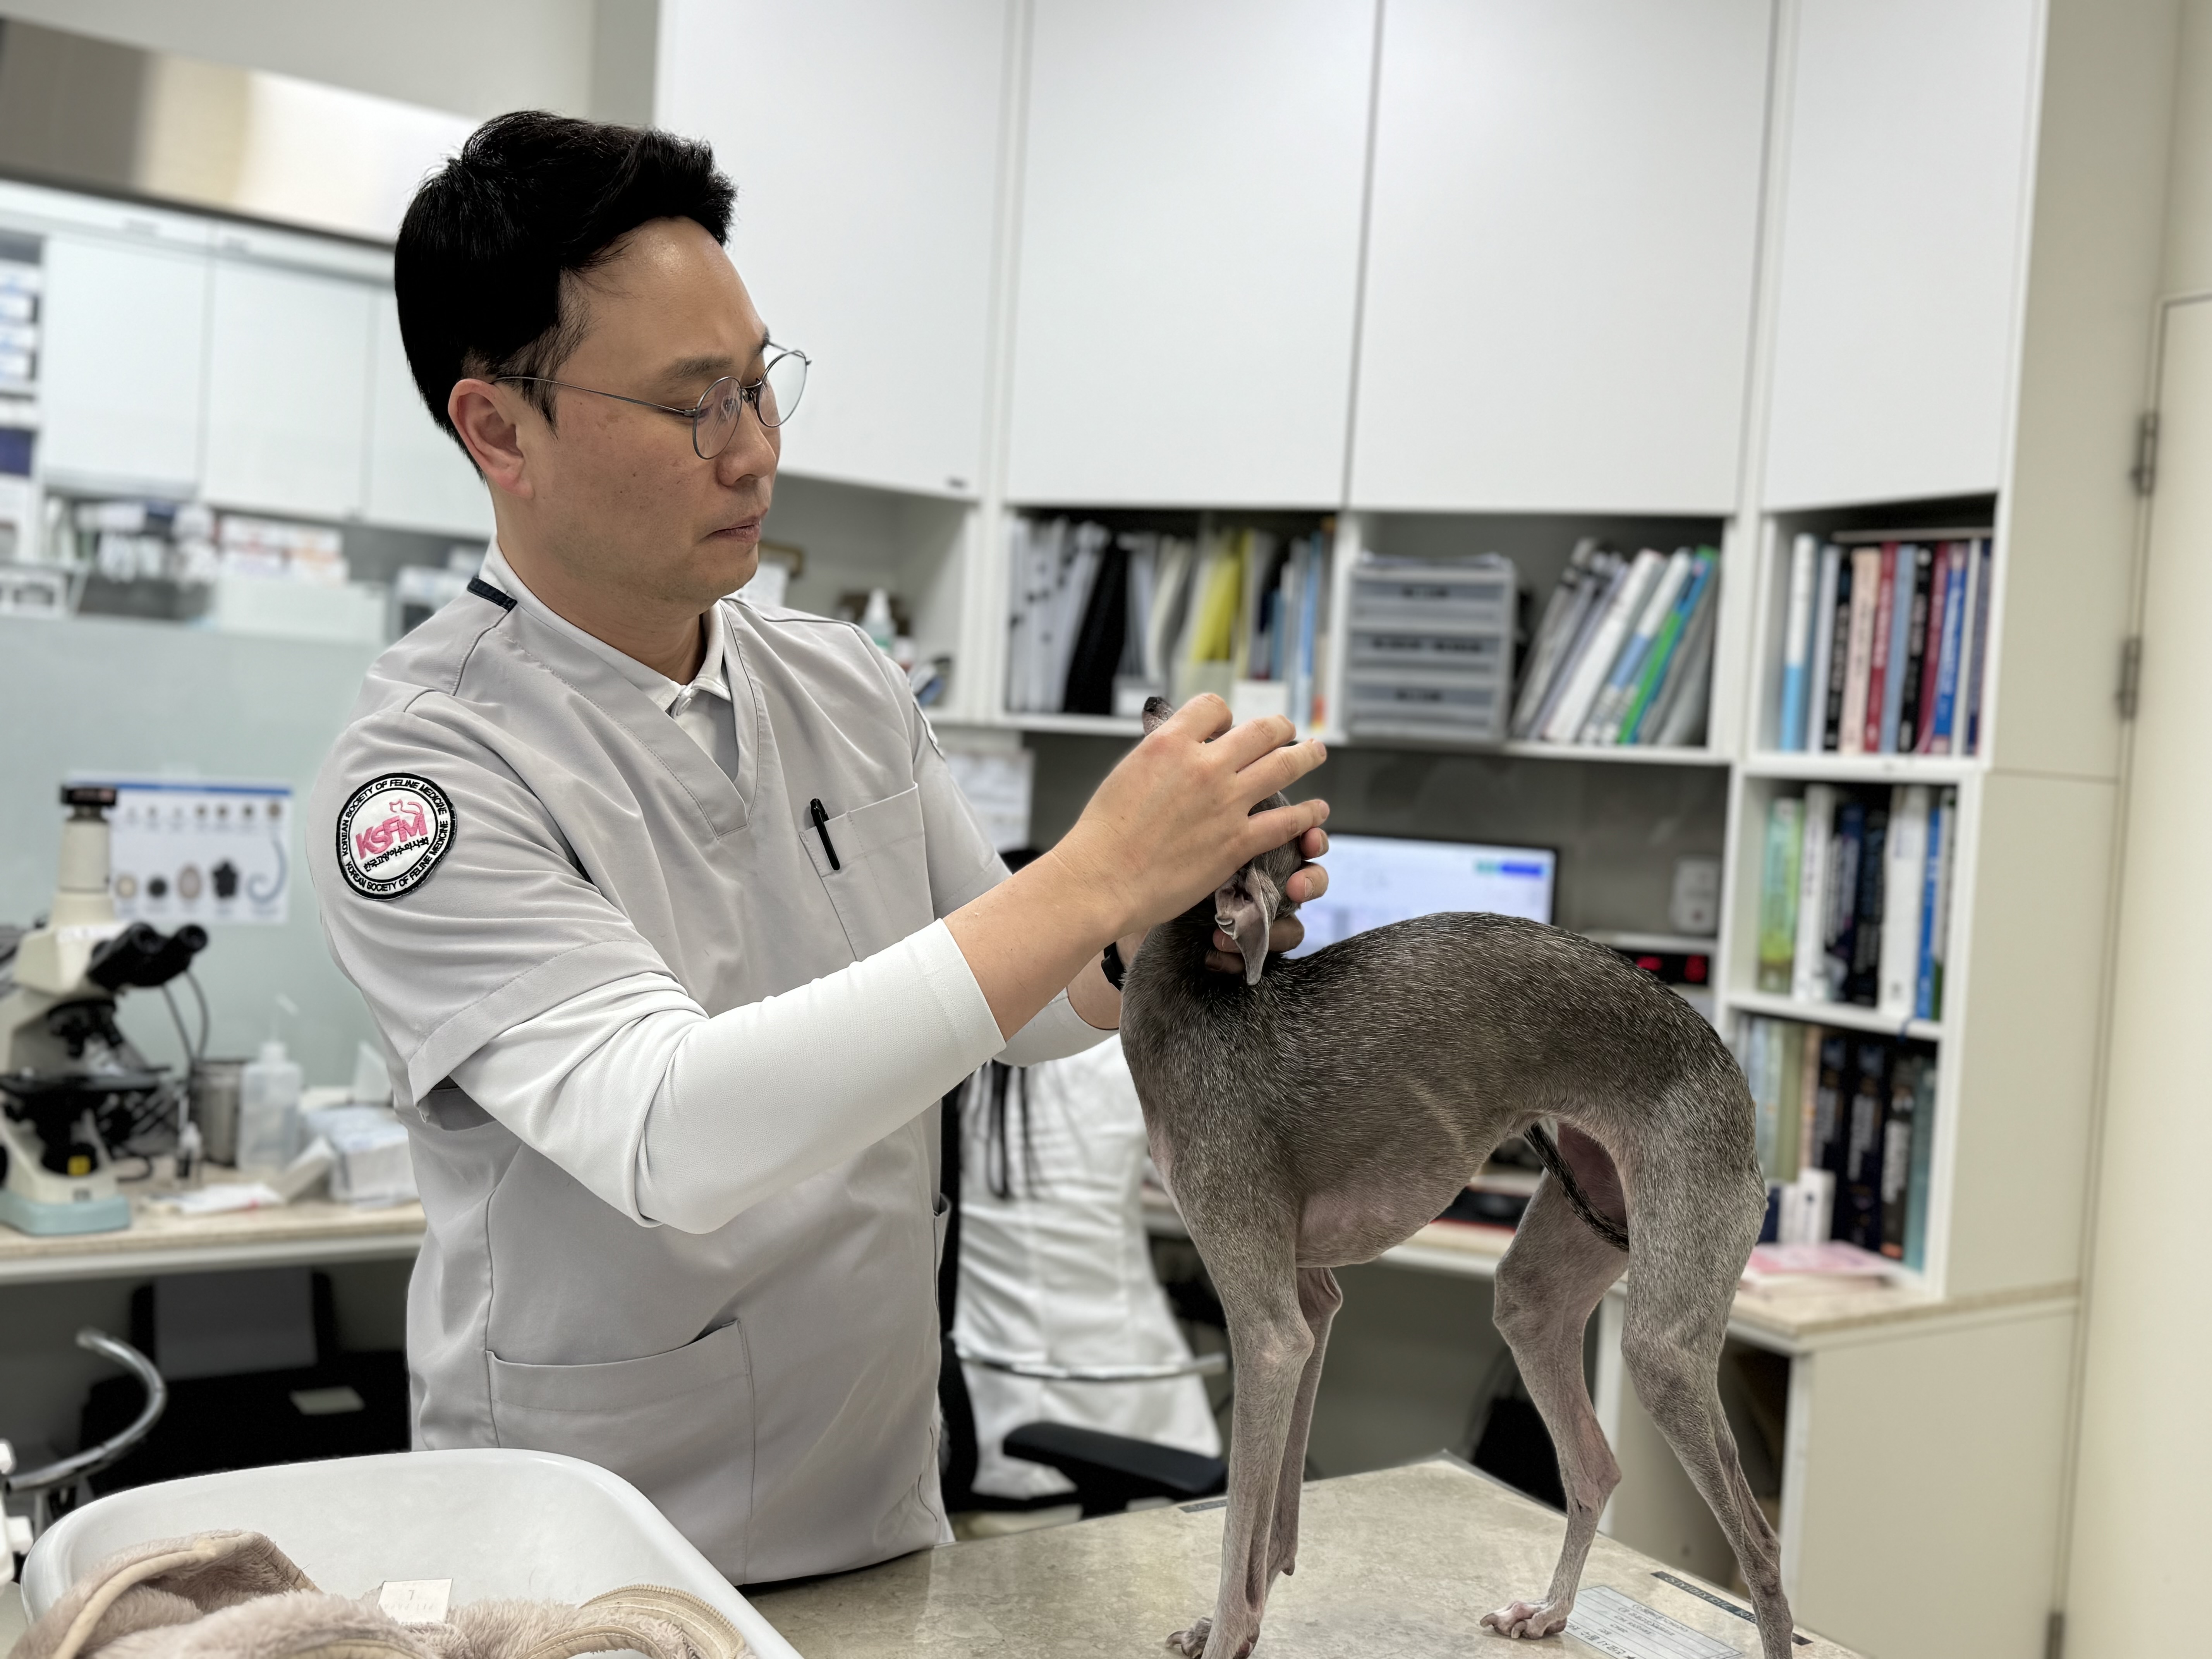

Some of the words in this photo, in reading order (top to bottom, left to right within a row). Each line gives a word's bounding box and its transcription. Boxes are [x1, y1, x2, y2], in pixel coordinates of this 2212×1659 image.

[346, 786, 373, 818] SOCIETY
[376, 780, 388, 790] OF
[390, 779, 419, 789] FELINE
[419, 784, 447, 815] MEDICINE
[346, 862, 366, 888] KOREAN
[367, 881, 397, 891] SOCIETY
[399, 877, 409, 887] OF
[410, 856, 431, 881] FELINE
[430, 820, 448, 857] MEDICINE
[356, 814, 428, 860] KSFM
[364, 836, 429, 872] 한국고양이수의사회
[409, 1590, 415, 1601] L
